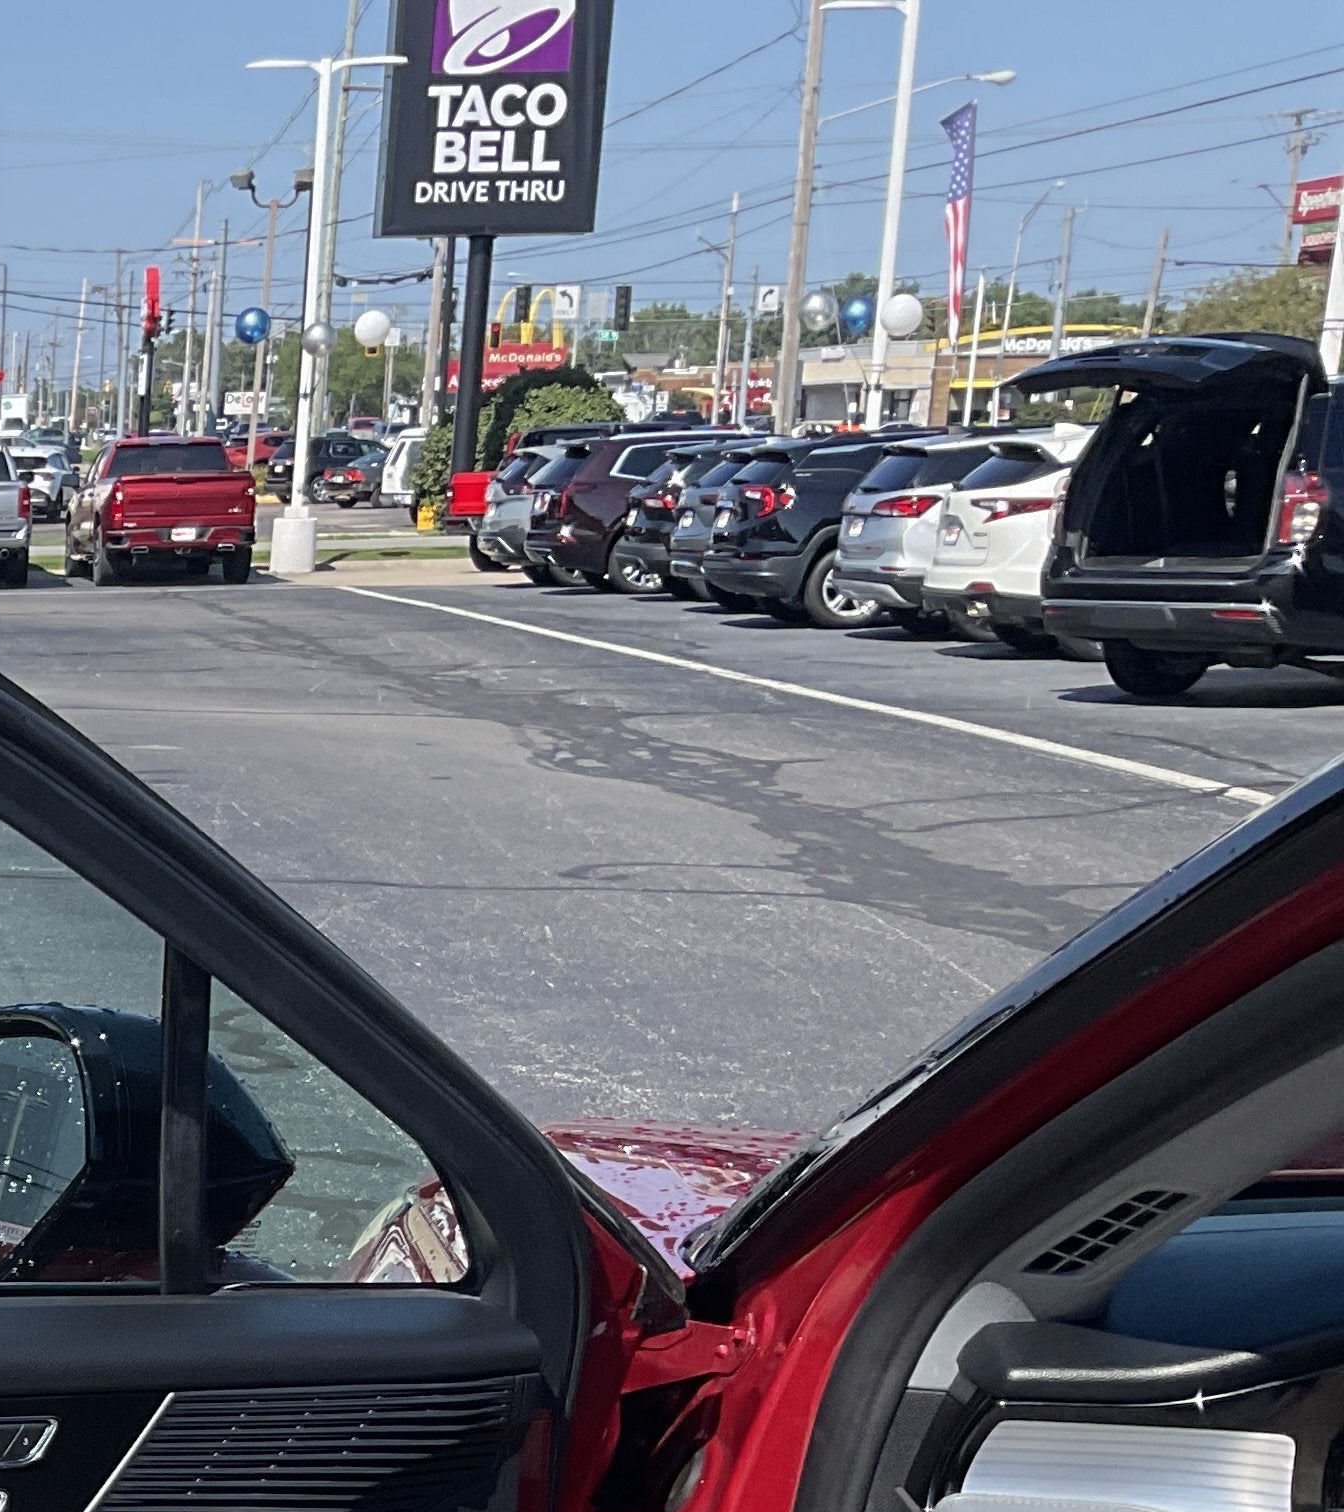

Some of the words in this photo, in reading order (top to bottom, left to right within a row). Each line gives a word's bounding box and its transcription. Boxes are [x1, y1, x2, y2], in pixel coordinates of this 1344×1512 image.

[427, 82, 568, 128] TACO
[433, 129, 561, 174] BELL
[415, 180, 490, 203] DRIVE
[495, 179, 566, 203] THRU
[488, 352, 562, 363] McDonald's
[226, 392, 265, 408] DeLor
